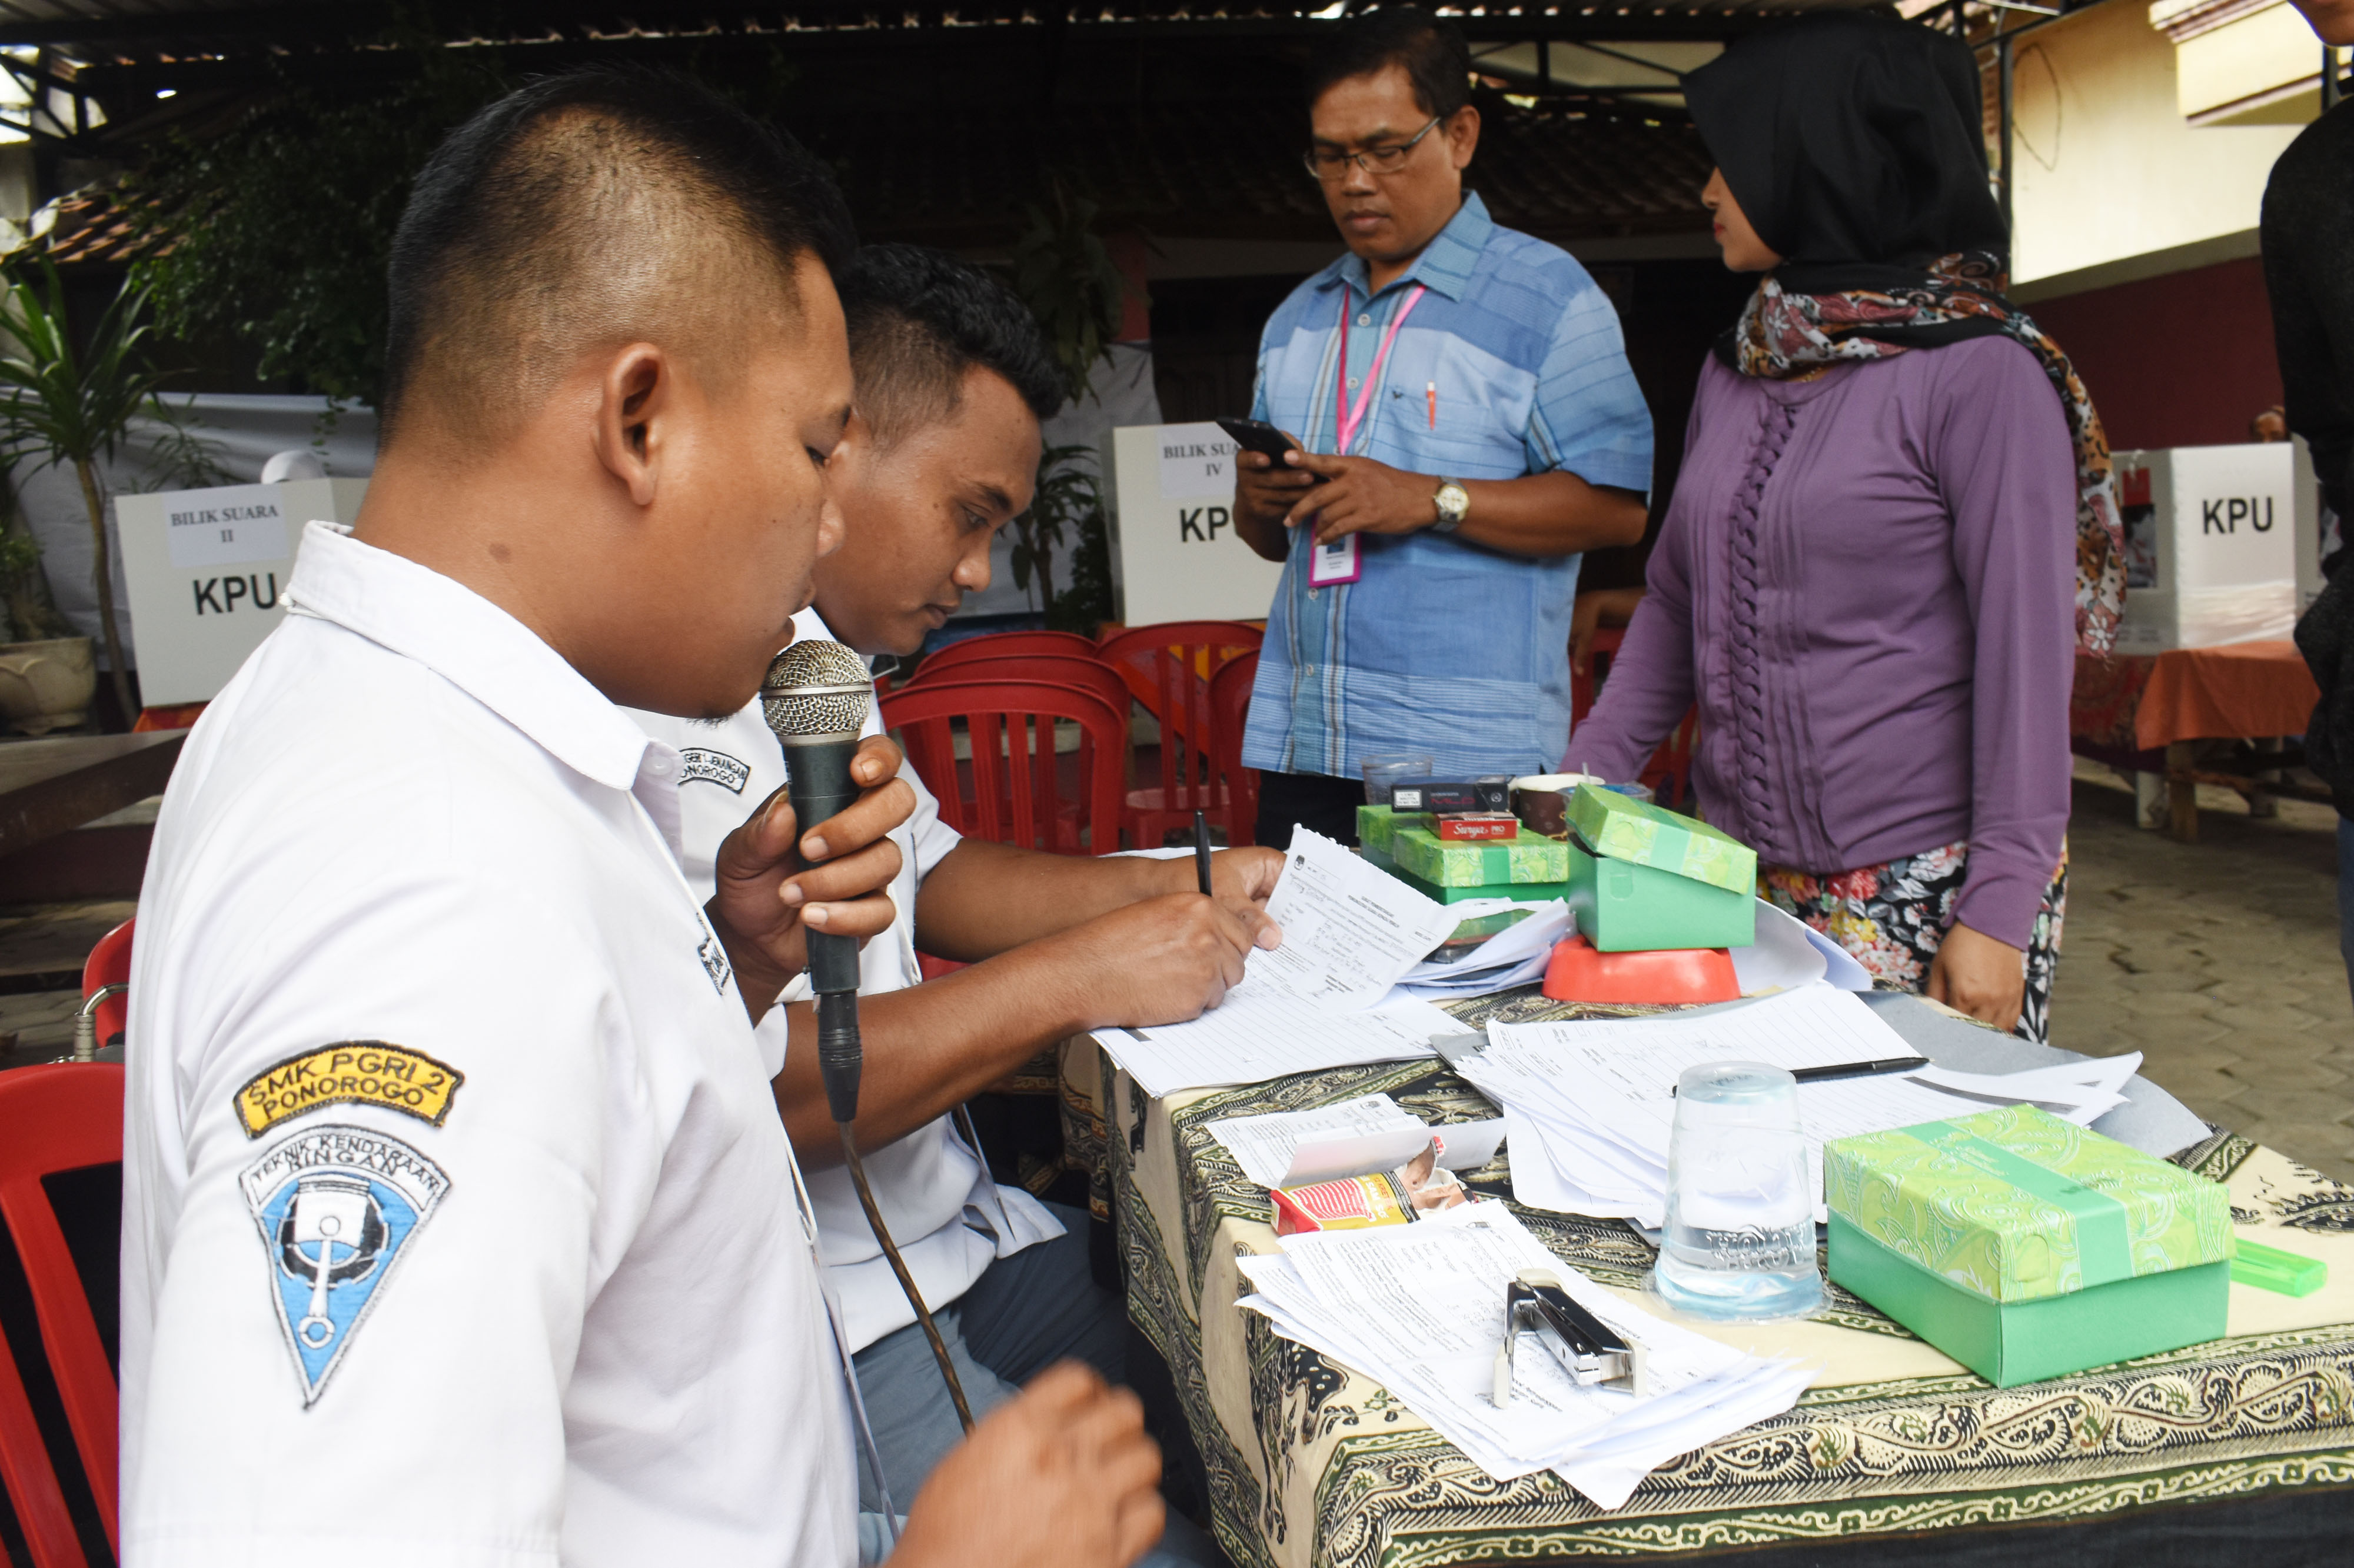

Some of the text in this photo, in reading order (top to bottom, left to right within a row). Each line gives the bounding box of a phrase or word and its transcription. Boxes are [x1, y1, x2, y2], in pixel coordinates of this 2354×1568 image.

[1163, 444, 1206, 458] BILIK
[1206, 462, 1223, 476] IV
[171, 505, 278, 527] BILIK SUARA
[1179, 507, 1229, 542] KP
[2203, 497, 2273, 534] KPU
[221, 530, 234, 543] II
[193, 572, 278, 615] KPU
[248, 1052, 445, 1106] SMK PGRI 2
[262, 1076, 424, 1120] PONOROGO
[251, 1133, 440, 1190] TEKNIK KENDARAAN
